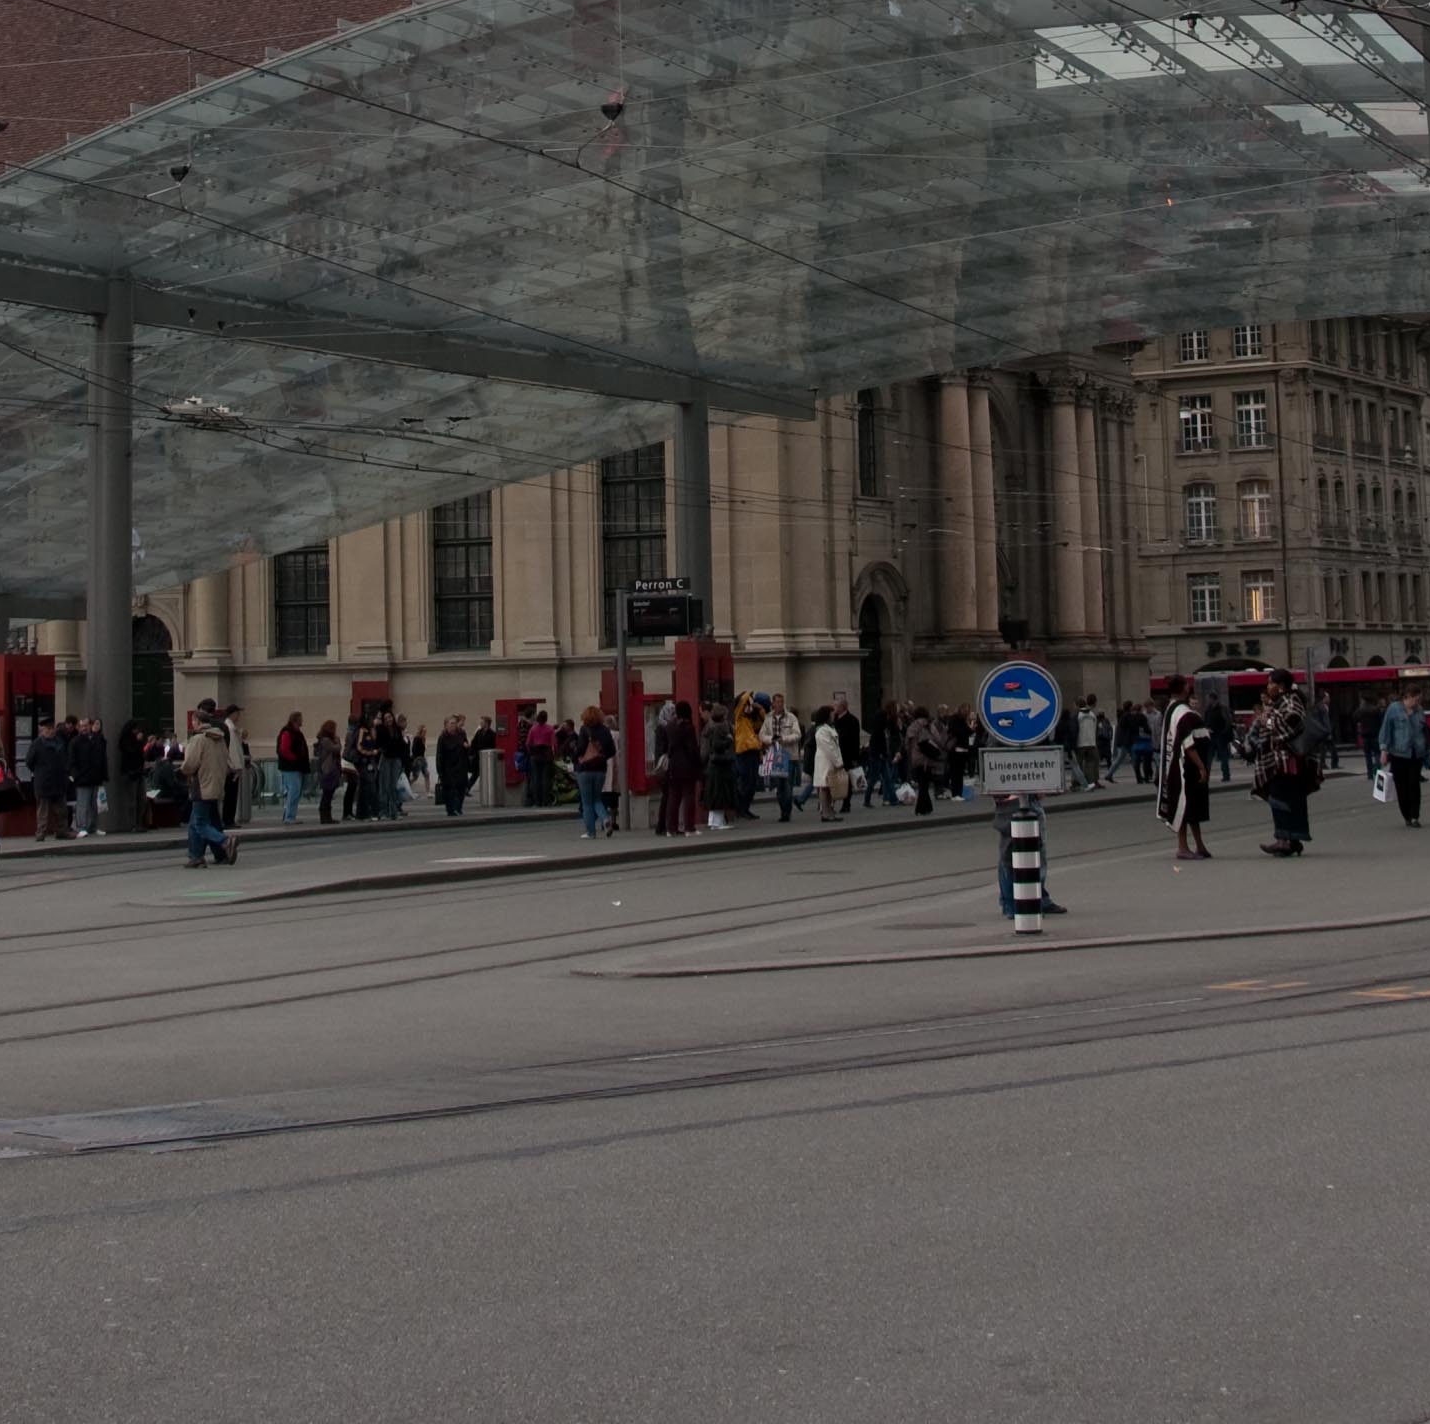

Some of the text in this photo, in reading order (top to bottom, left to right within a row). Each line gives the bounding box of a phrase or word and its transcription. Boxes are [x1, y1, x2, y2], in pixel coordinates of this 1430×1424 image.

[635, 579, 683, 590] Perron C
[989, 760, 1055, 770] Linienverkehr
[1000, 772, 1046, 783] gestattet
